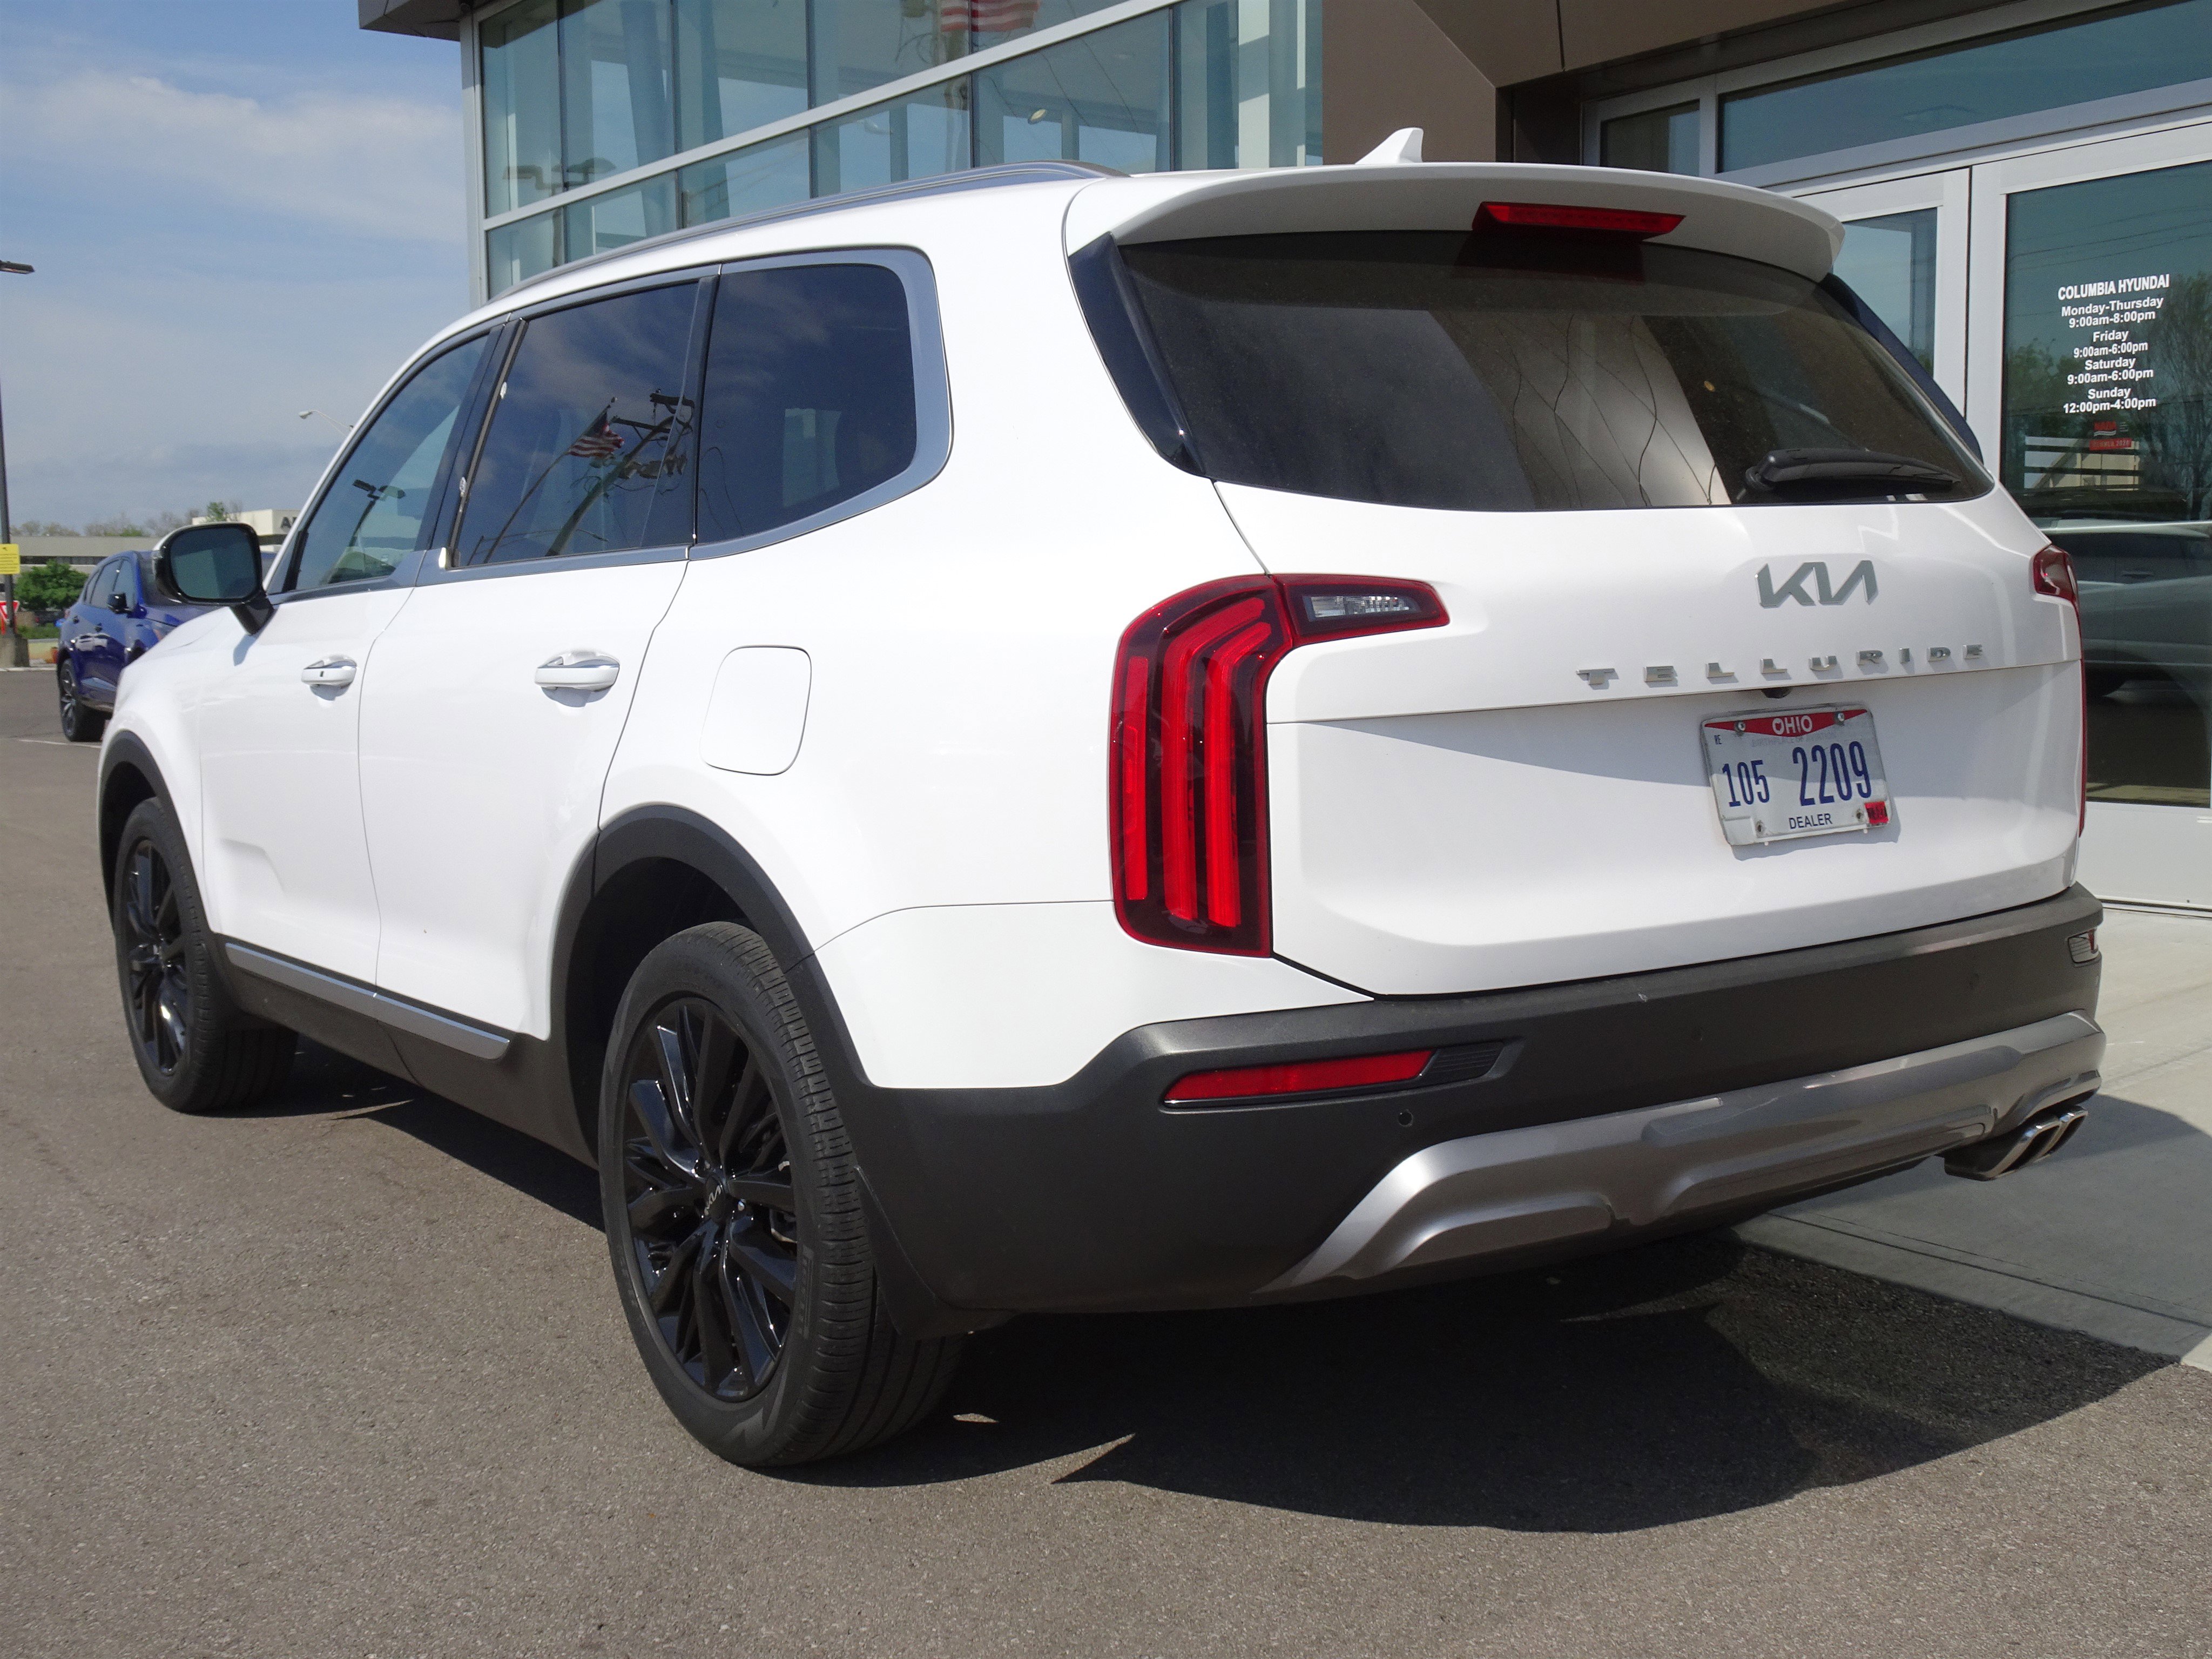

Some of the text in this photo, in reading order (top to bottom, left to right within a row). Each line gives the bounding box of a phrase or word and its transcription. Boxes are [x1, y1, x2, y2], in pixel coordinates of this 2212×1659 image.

[2058, 274, 2169, 300] COLUMBIA HYUNDAI
[2062, 297, 2163, 316] Monday-Thursday
[2069, 311, 2155, 328] 9:00am-8:00pm
[2093, 330, 2129, 342] Friday
[2074, 342, 2148, 358] 9:00am-6:00pm
[2085, 357, 2136, 370] Saturday
[2068, 369, 2153, 385] 9:00am-6:00pm
[2088, 387, 2130, 399] Sunday
[2063, 398, 2156, 413] 12:00pm-4:00pm
[1755, 560, 1878, 608] KIA
[1576, 644, 1982, 685] TELLURIDE
[1772, 715, 1813, 736] OHIO
[1722, 740, 1872, 807] 105 2209
[1789, 813, 1833, 830] DEALER
